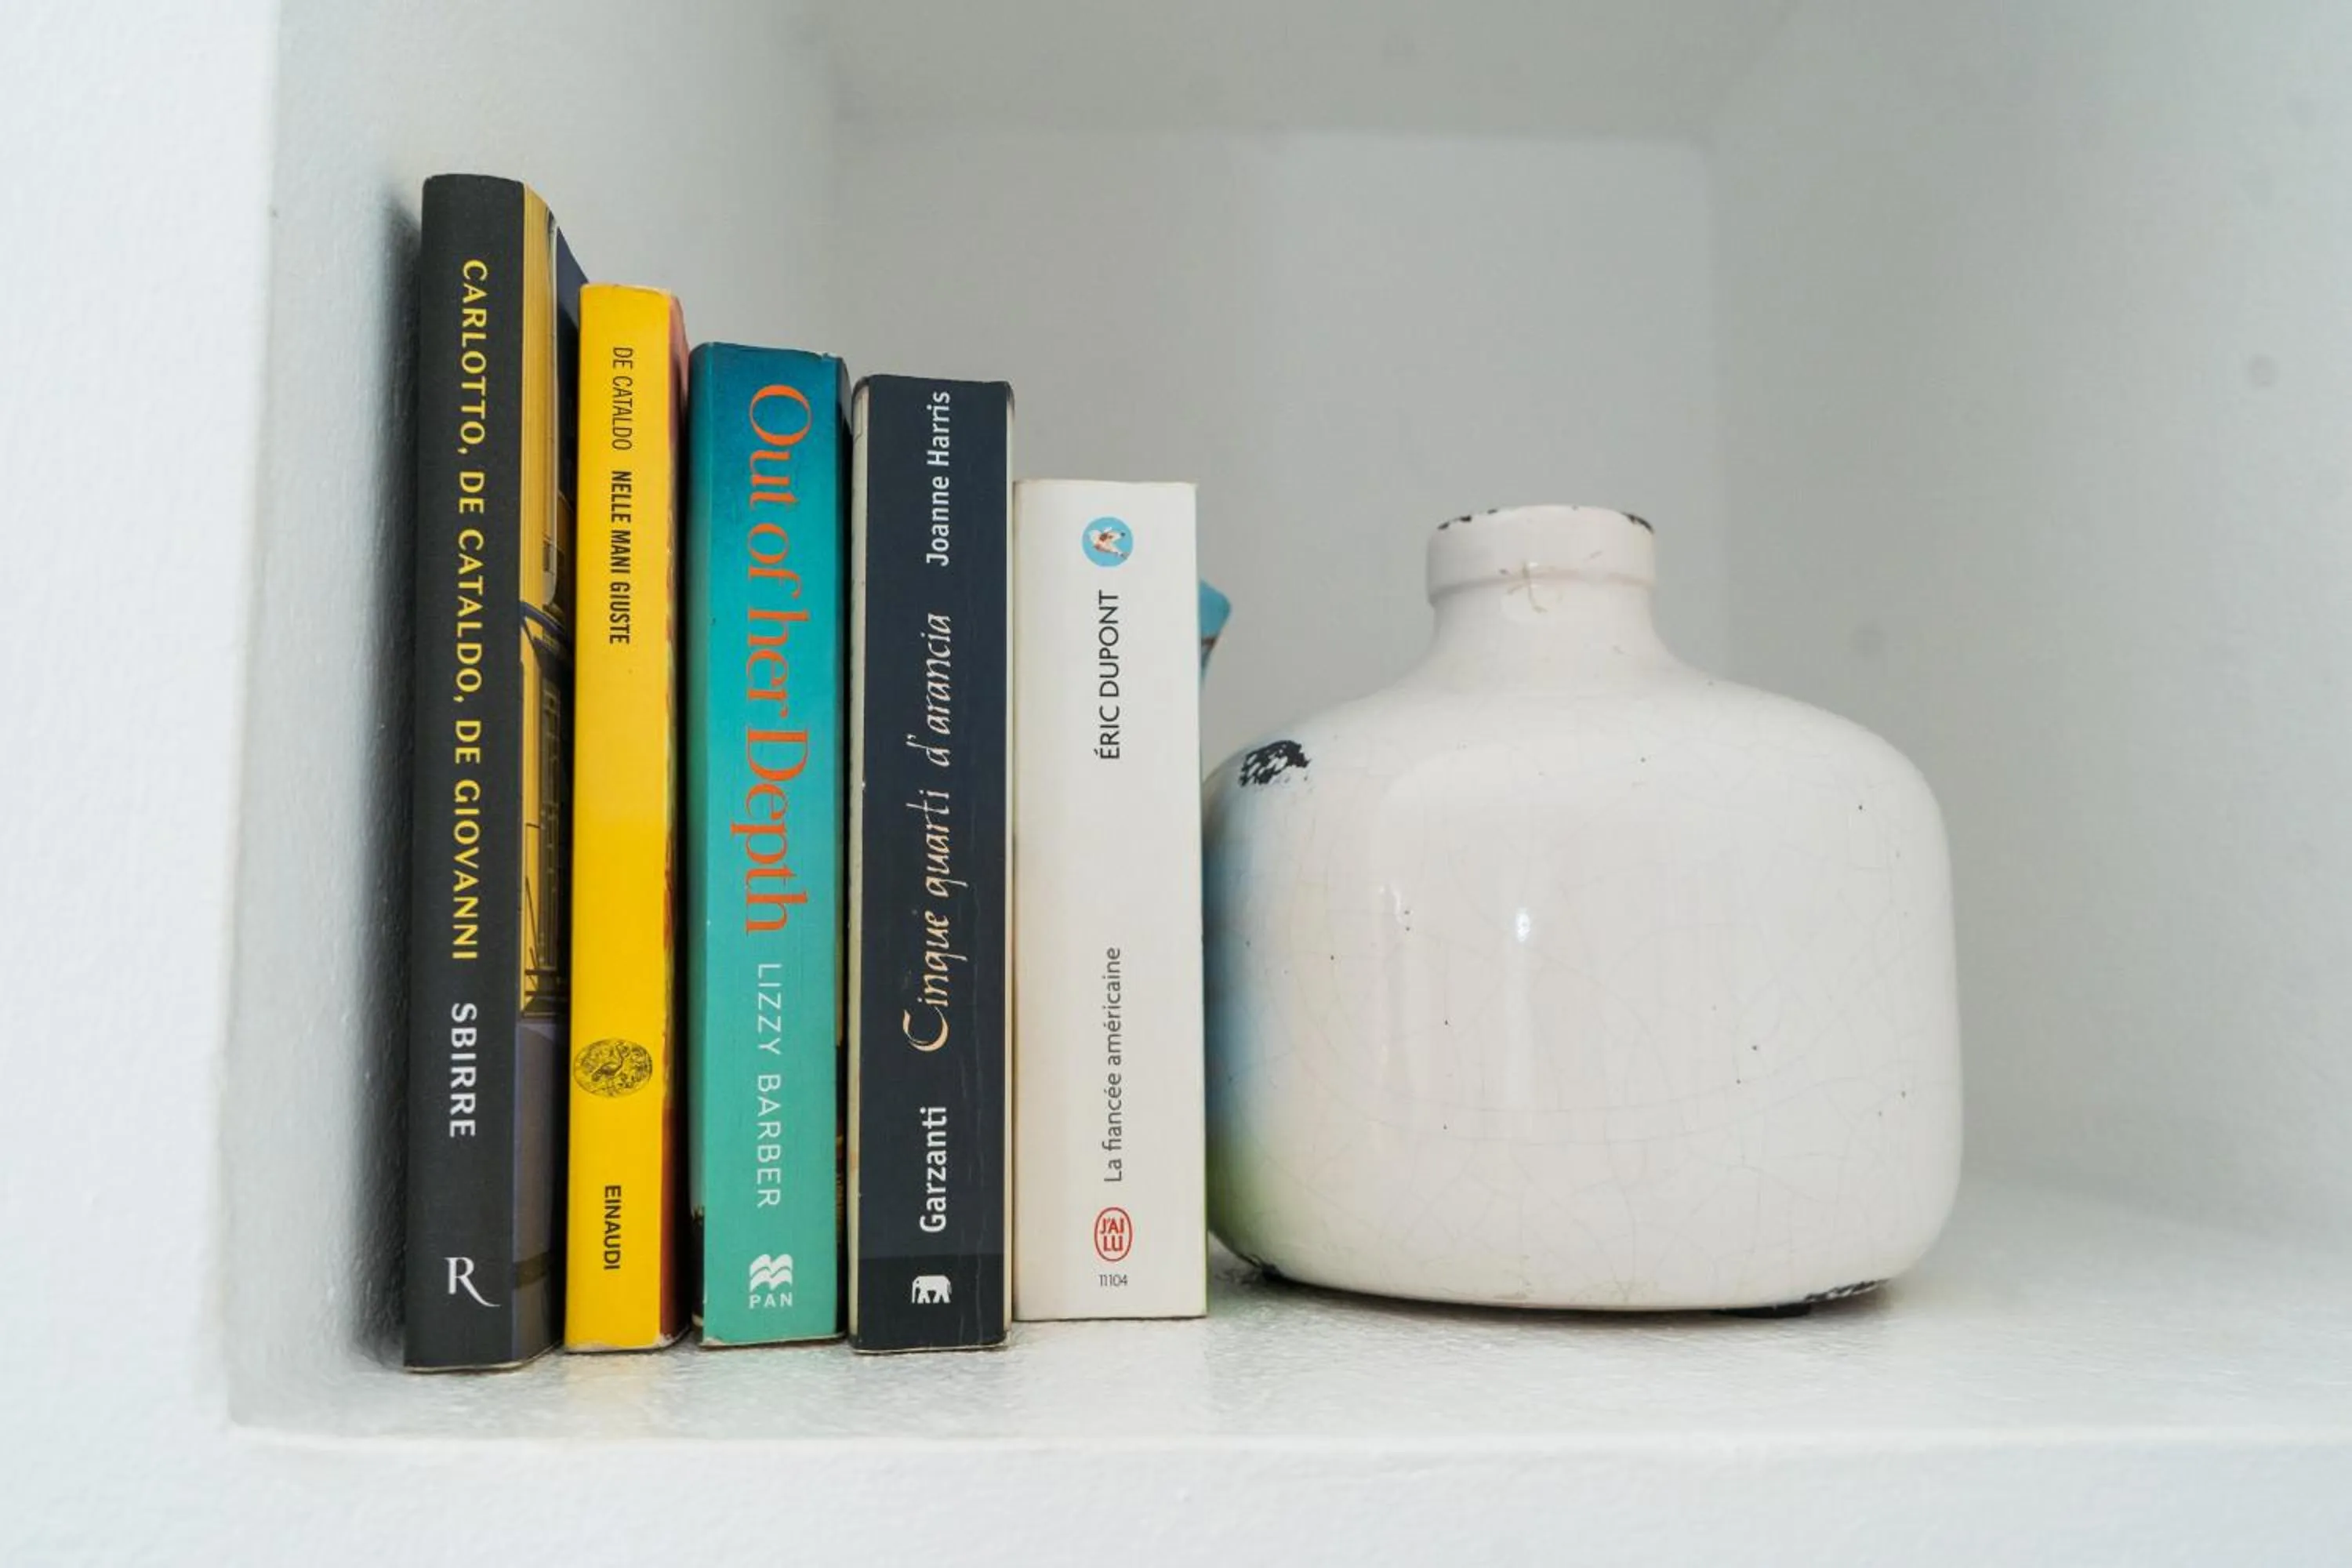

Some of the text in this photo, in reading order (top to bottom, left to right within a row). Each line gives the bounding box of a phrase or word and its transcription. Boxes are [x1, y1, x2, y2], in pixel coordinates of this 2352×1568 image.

[612, 347, 633, 451] DE CATALDO
[926, 391, 950, 566] Joanne Harris
[452, 260, 488, 959] CARLOTTO, DE CATALDO, DE GIOVANNI
[609, 471, 632, 644] NELLE MANI GIUSTE
[730, 384, 812, 936] Out of her Depth
[1093, 590, 1120, 759] ÉRIC DUPONT
[902, 612, 967, 1051] Cinque quarti d'arancia
[449, 1003, 477, 1138] SBIRRE
[757, 963, 783, 1208] LIZZY BARBER
[1102, 947, 1123, 1182] La fiancée américaine
[604, 1185, 621, 1270] EINAUDI
[920, 1106, 947, 1233] Garzanti
[1099, 1218, 1125, 1235] J'AI
[446, 1257, 502, 1307] R
[749, 1294, 793, 1308] PAN
[1099, 1273, 1128, 1287] 11104
[1103, 1236, 1123, 1252] LU
